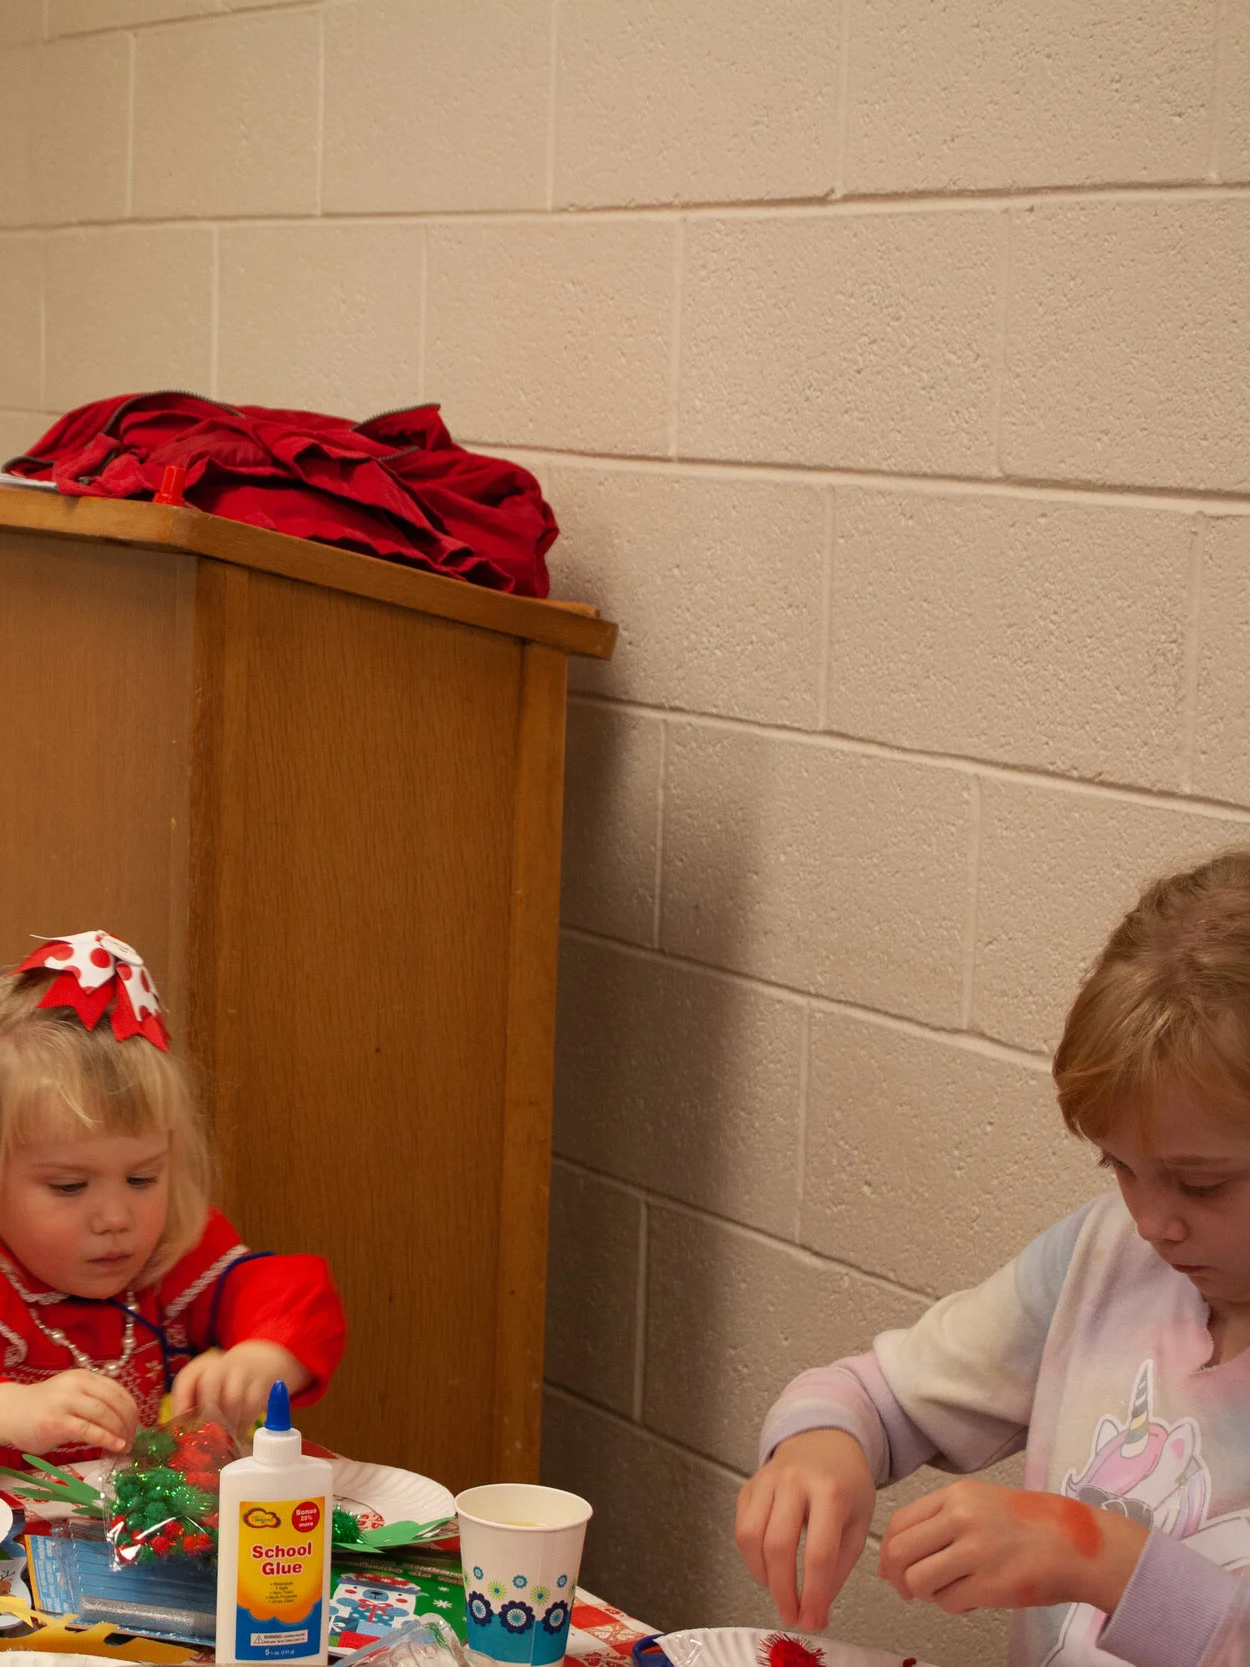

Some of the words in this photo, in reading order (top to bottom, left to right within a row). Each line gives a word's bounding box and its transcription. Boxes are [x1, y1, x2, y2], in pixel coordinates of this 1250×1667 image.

[296, 1508, 317, 1516] Bonus
[252, 1542, 312, 1559] School
[261, 1562, 302, 1576] Glue
